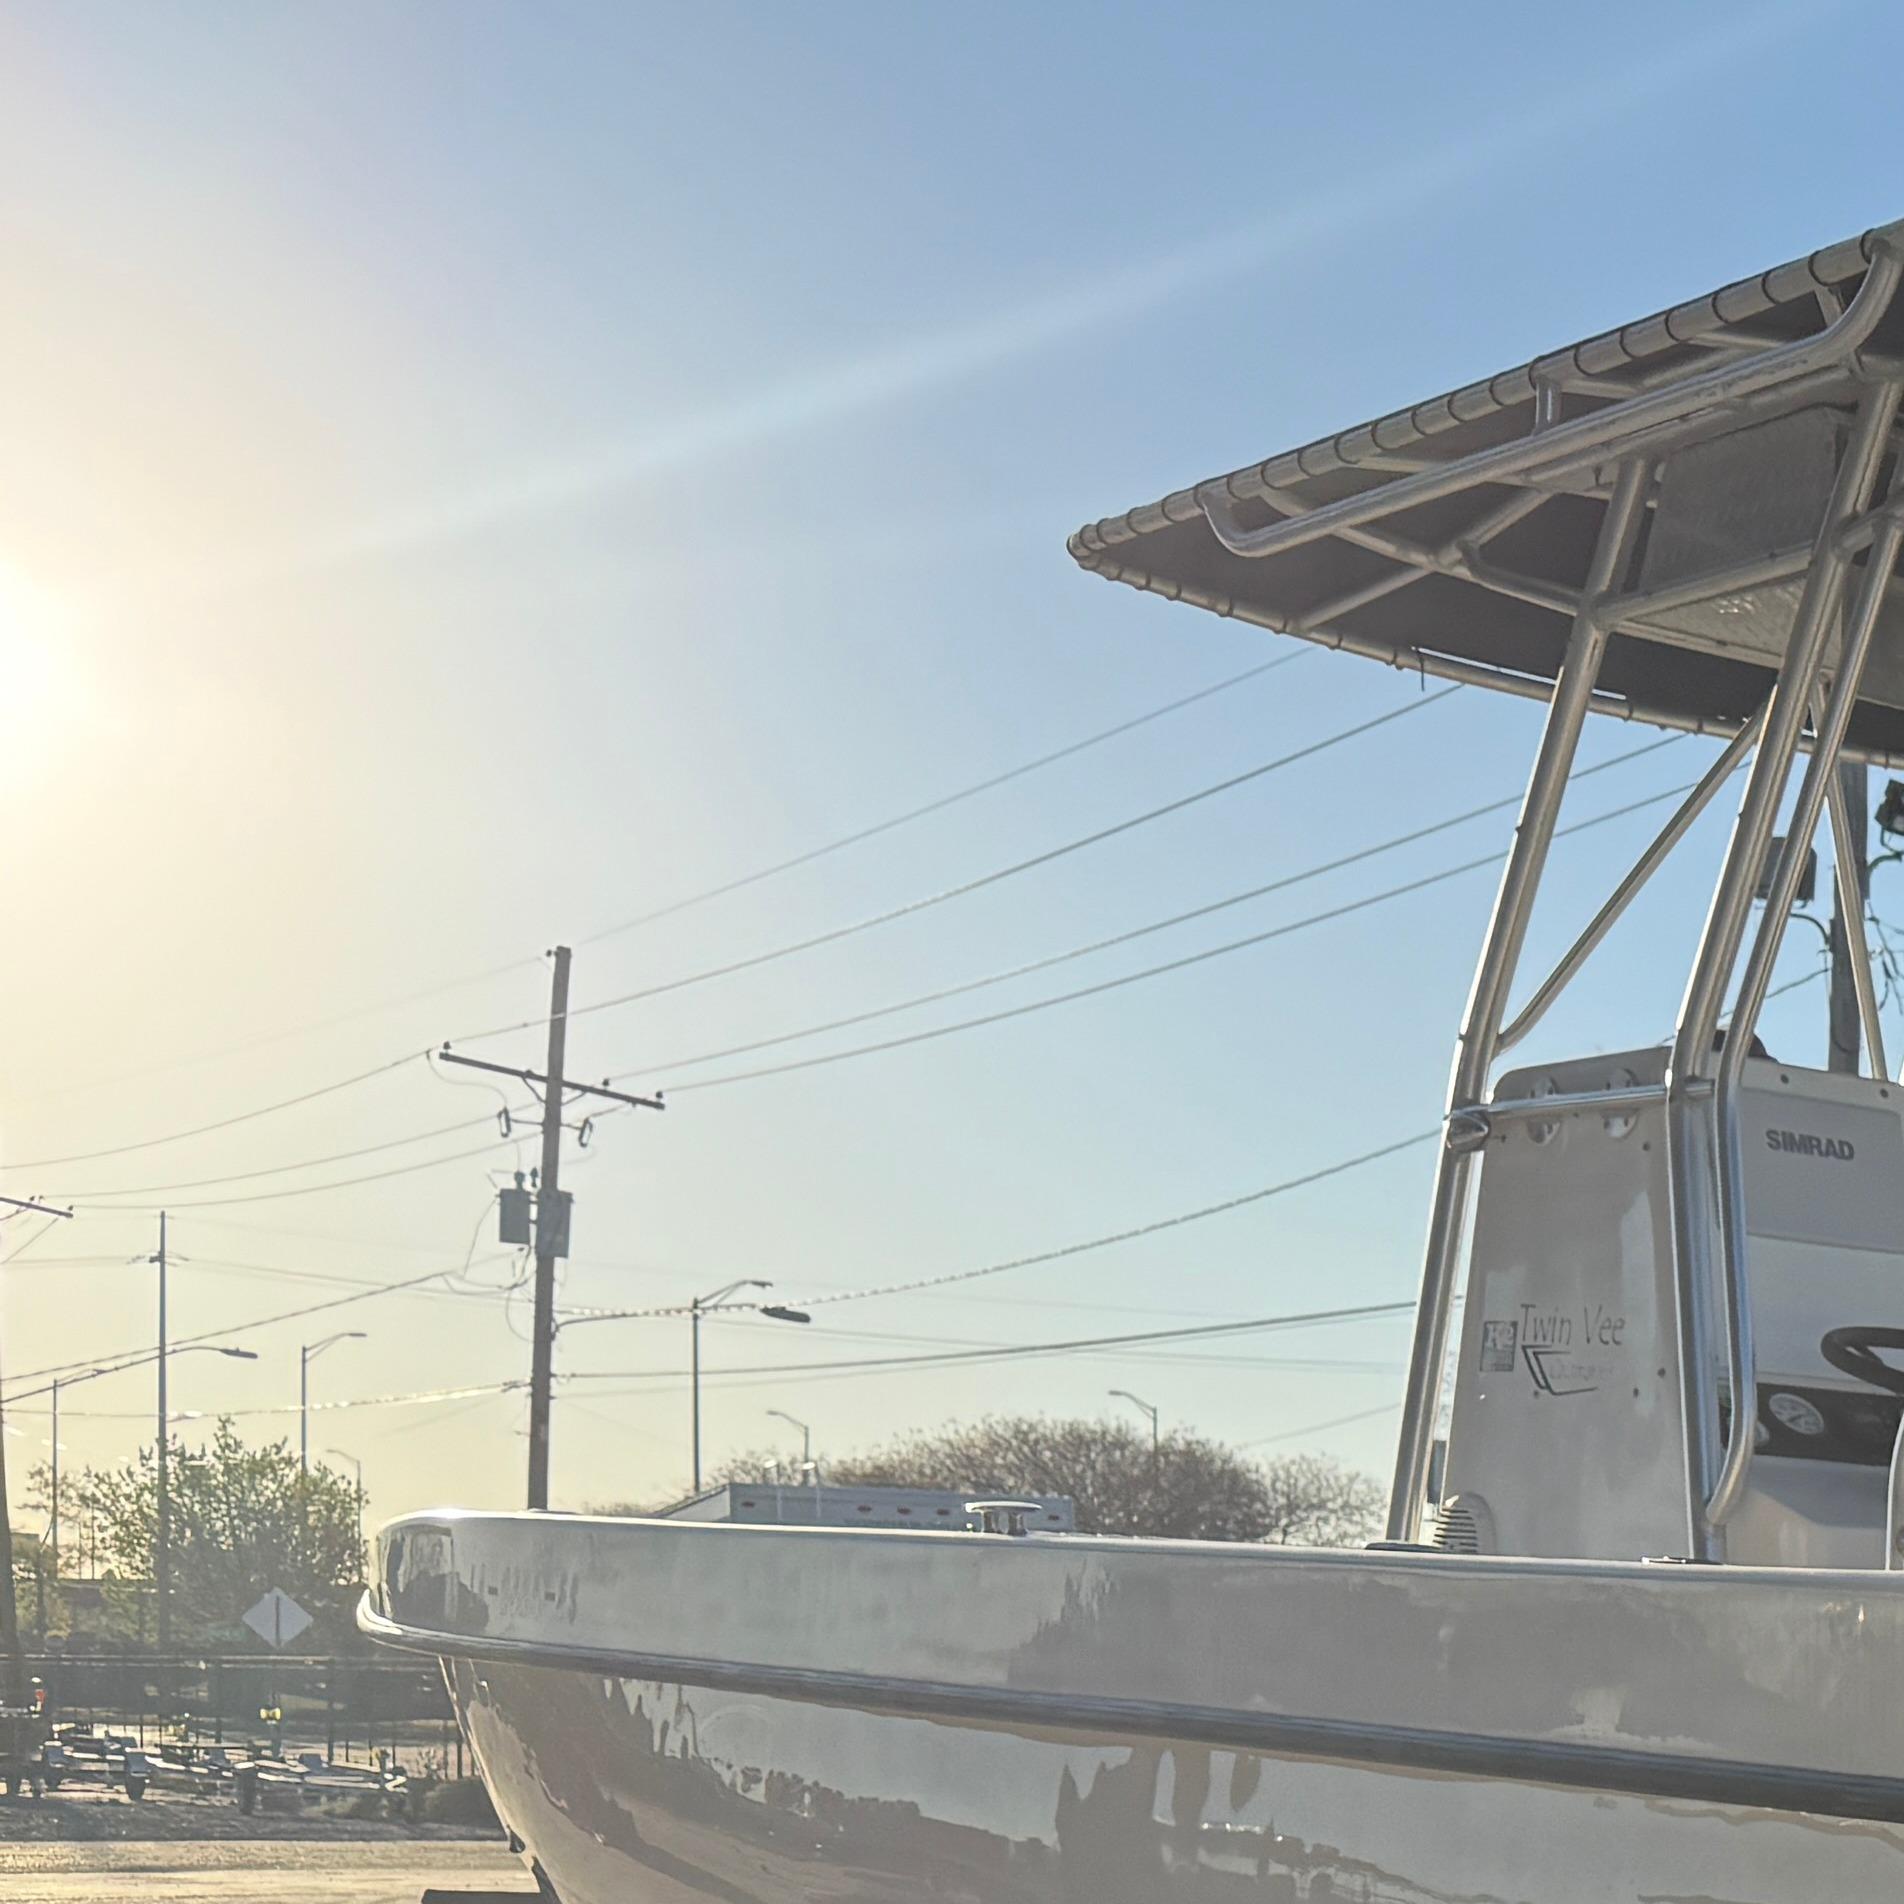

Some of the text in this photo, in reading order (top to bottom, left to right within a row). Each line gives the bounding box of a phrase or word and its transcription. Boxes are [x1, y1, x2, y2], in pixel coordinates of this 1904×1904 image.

[1765, 1129, 1855, 1161] SIMRAD
[1520, 1303, 1626, 1346] Twin Vee
